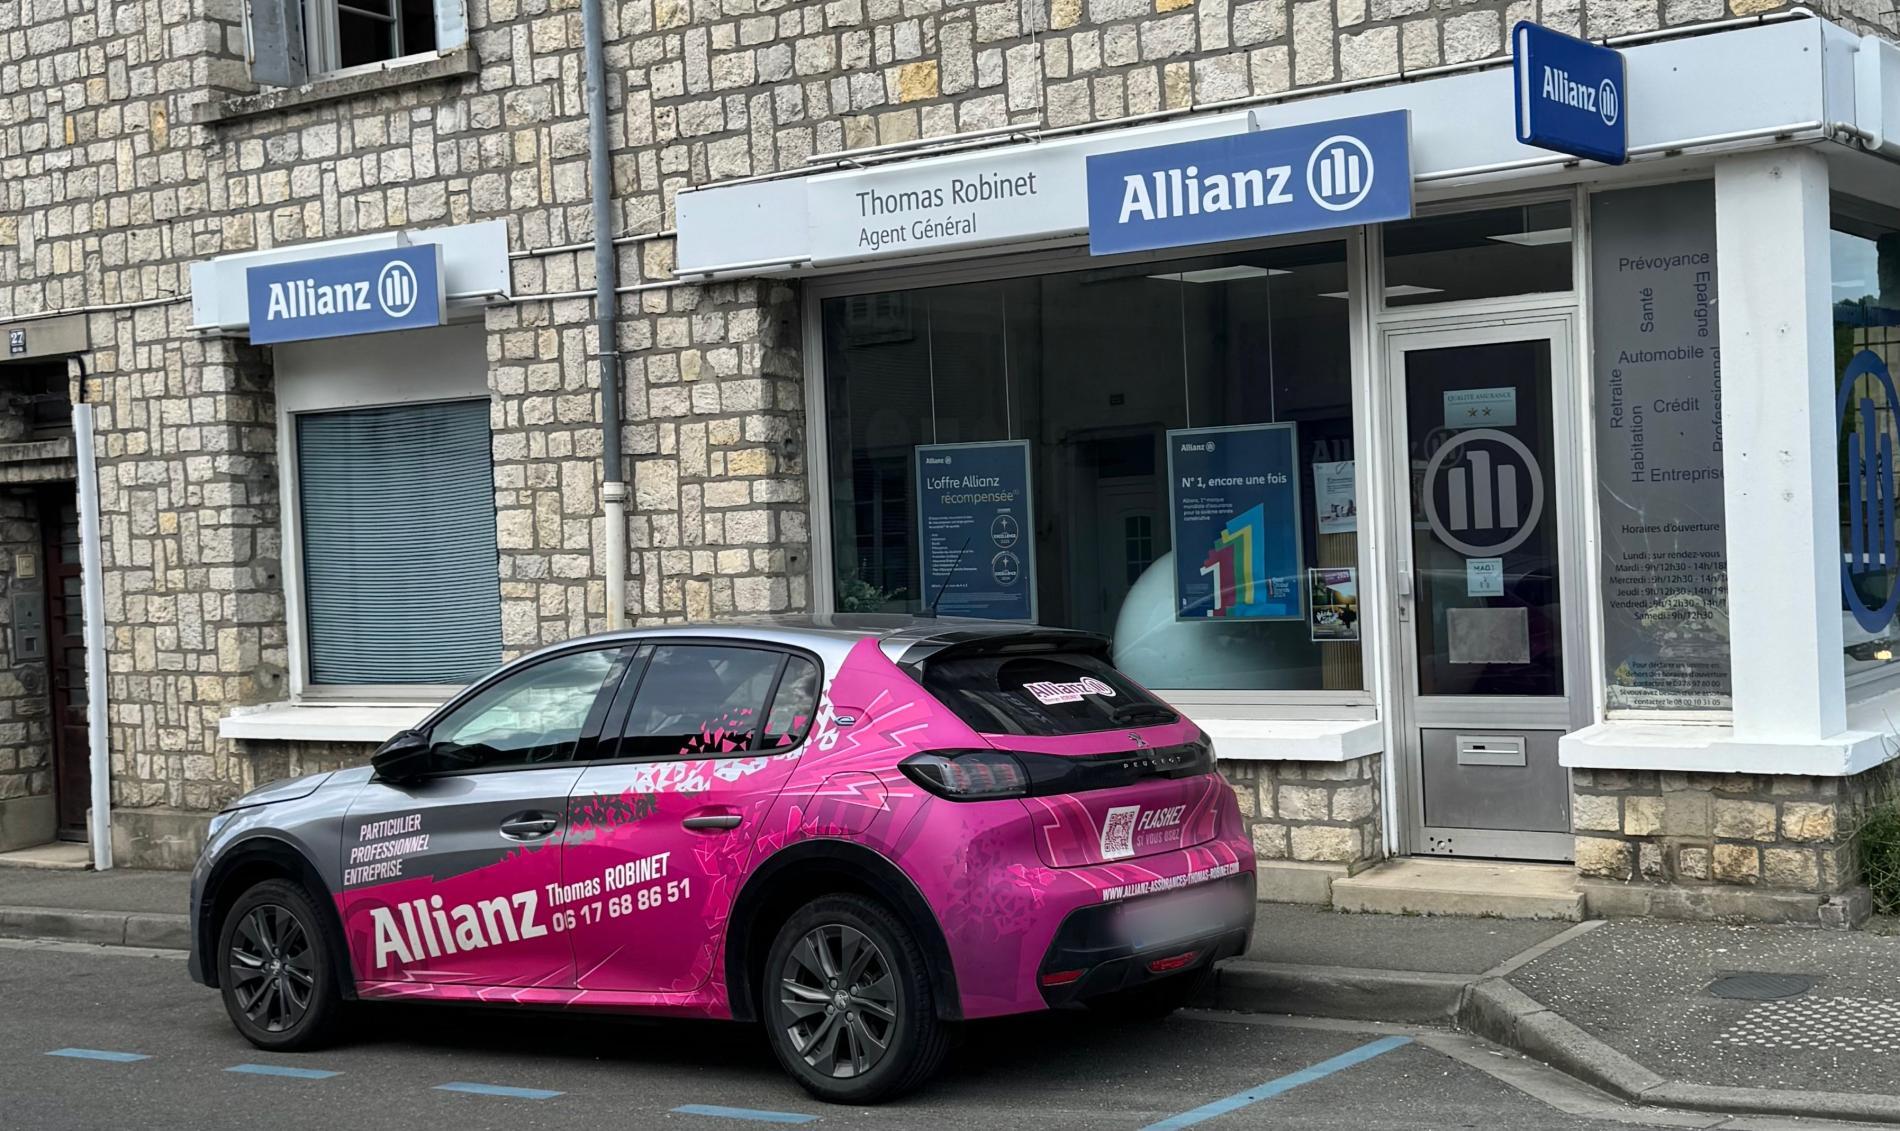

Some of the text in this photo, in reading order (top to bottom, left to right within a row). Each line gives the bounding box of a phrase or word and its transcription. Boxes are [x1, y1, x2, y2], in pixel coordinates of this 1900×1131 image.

[1542, 65, 1597, 112] Allianz
[856, 172, 1037, 217] Thomas Robinet
[1118, 165, 1294, 224] Allianz
[858, 213, 976, 250] Agent Général
[1619, 252, 1710, 272] Prévoyance
[267, 278, 372, 321] Allianz
[1640, 287, 1654, 333] Santé
[1694, 271, 1711, 338] Epargne
[10, 331, 24, 344] 27
[1618, 345, 1704, 364] Automobile
[1610, 368, 1623, 429] Retraite
[1653, 397, 1700, 414] Crédit
[1180, 443, 1205, 452] Allianz
[1631, 405, 1645, 483] Habitation
[926, 475, 1000, 490] L'offre Allianz
[1181, 477, 1195, 488] N°
[1208, 477, 1243, 487] encore
[1245, 475, 1265, 485] une
[1267, 472, 1287, 484] fois
[1621, 522, 1720, 534] Horaires d'ouverture
[1615, 563, 1640, 573] Mardi
[1623, 551, 1646, 560] Lundi
[1667, 550, 1720, 559] rendez-vous
[1609, 575, 1646, 584] Mercredi
[1617, 587, 1639, 596] Jeudi
[1609, 599, 1647, 608] Vendredi
[1633, 611, 1666, 621] Samedi
[1026, 681, 1091, 698] Allianz
[359, 813, 422, 842] PARTICULIER
[1137, 804, 1187, 831] FLASHEZ
[350, 834, 430, 865] PROFESSIONNEL
[344, 859, 403, 886] ENTREPRISE
[545, 851, 671, 907] Thomas ROBINET
[552, 877, 691, 932] 06 17 68 86 51
[369, 889, 548, 969] Allianz
